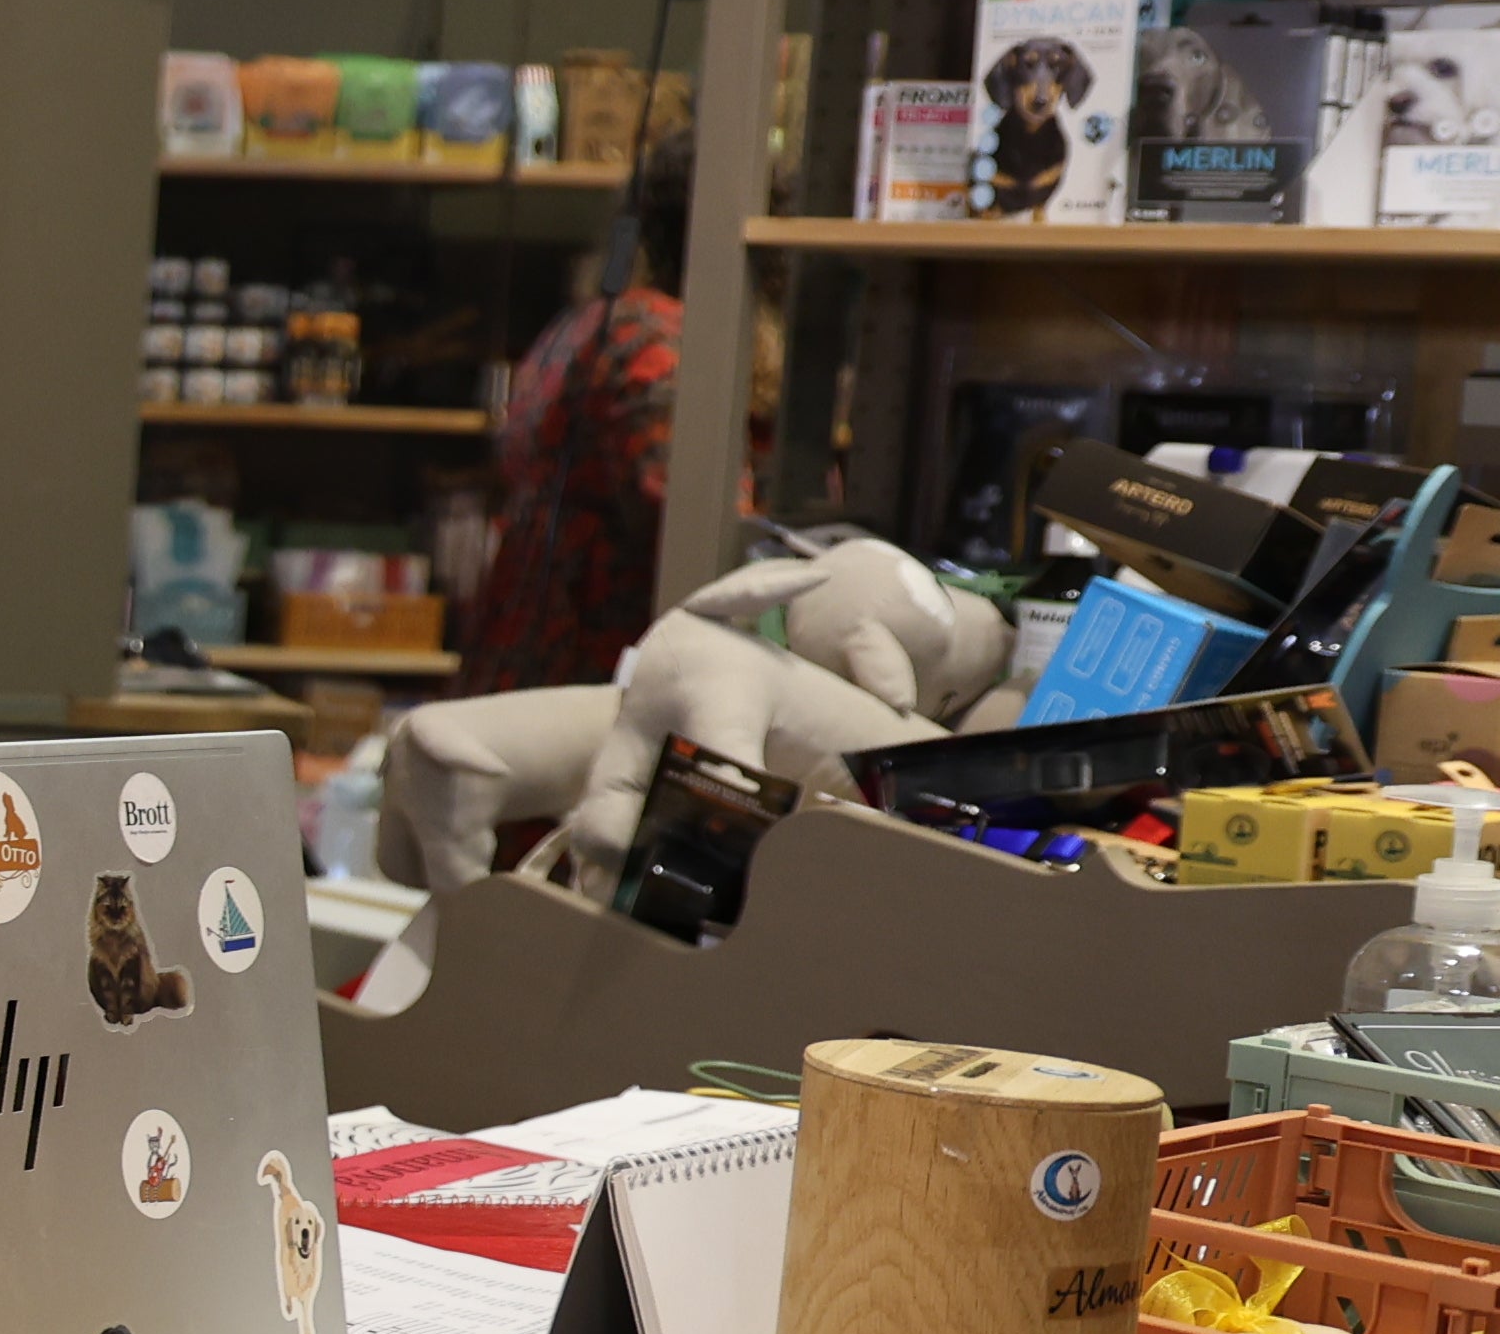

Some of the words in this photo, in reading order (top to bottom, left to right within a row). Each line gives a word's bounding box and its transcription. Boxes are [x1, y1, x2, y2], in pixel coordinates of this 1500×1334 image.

[1162, 146, 1277, 172] MERLIN
[1108, 477, 1195, 518] ARTERO
[123, 800, 171, 827] Brott
[1, 843, 37, 866] OTTO
